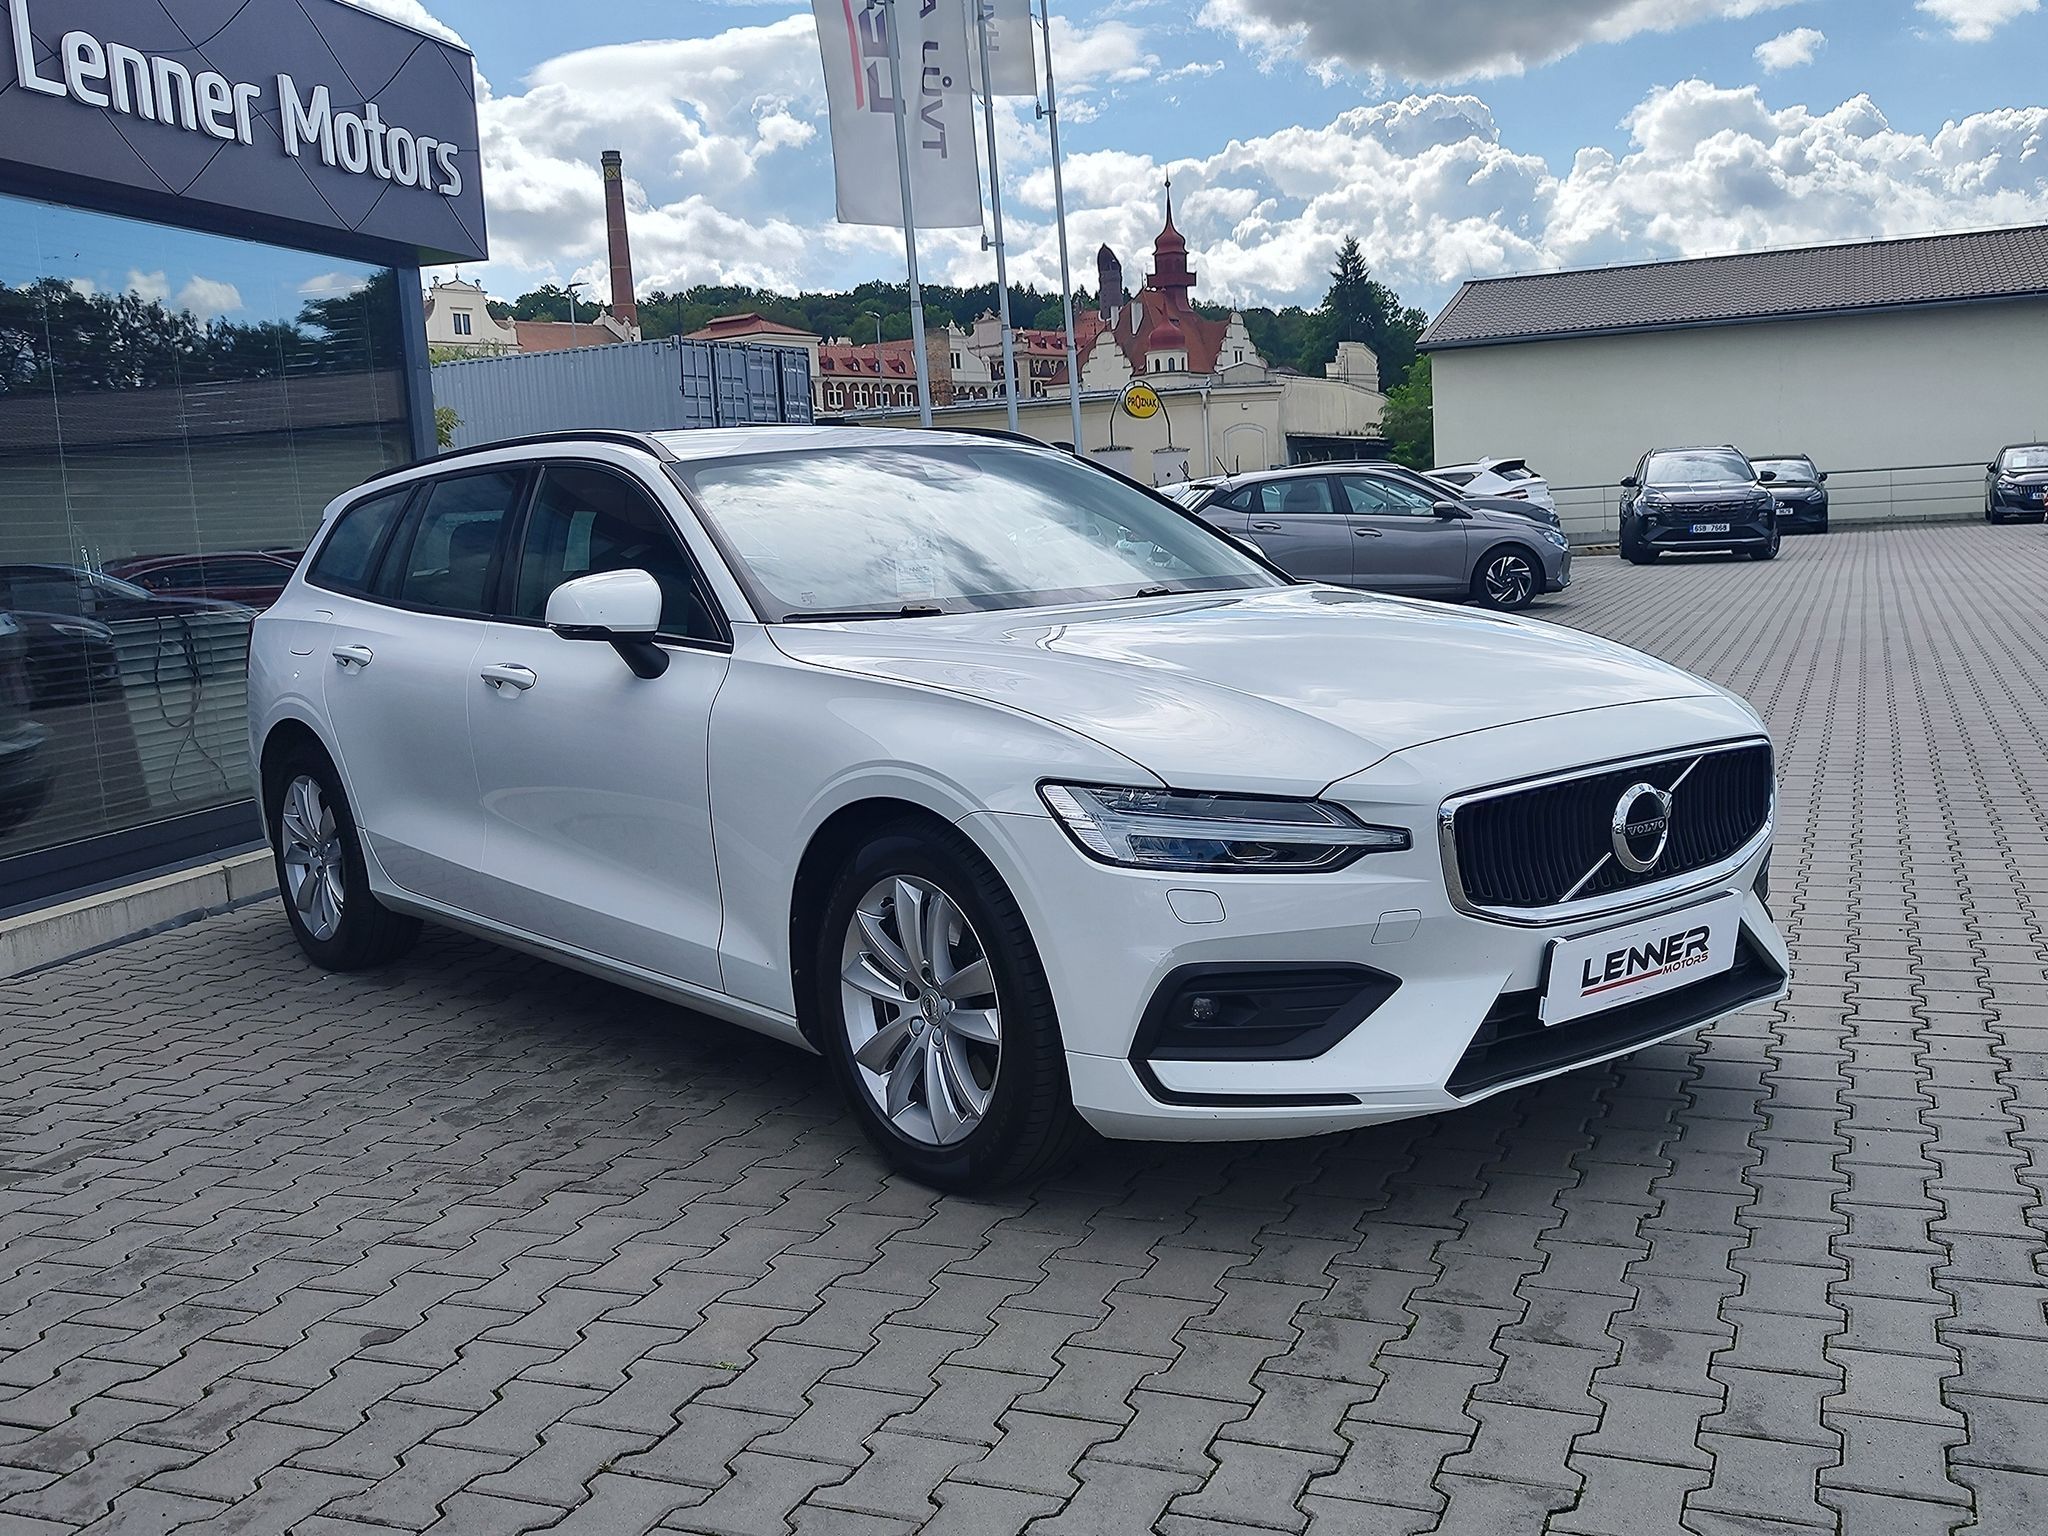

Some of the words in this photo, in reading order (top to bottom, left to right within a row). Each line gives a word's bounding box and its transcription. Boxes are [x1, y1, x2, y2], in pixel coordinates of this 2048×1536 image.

[9, 0, 260, 146] Lenner
[276, 73, 464, 197] Motors
[1627, 820, 1665, 836] VOLVO
[1581, 925, 1710, 988] LENNER
[1662, 952, 1709, 975] MOTORS
